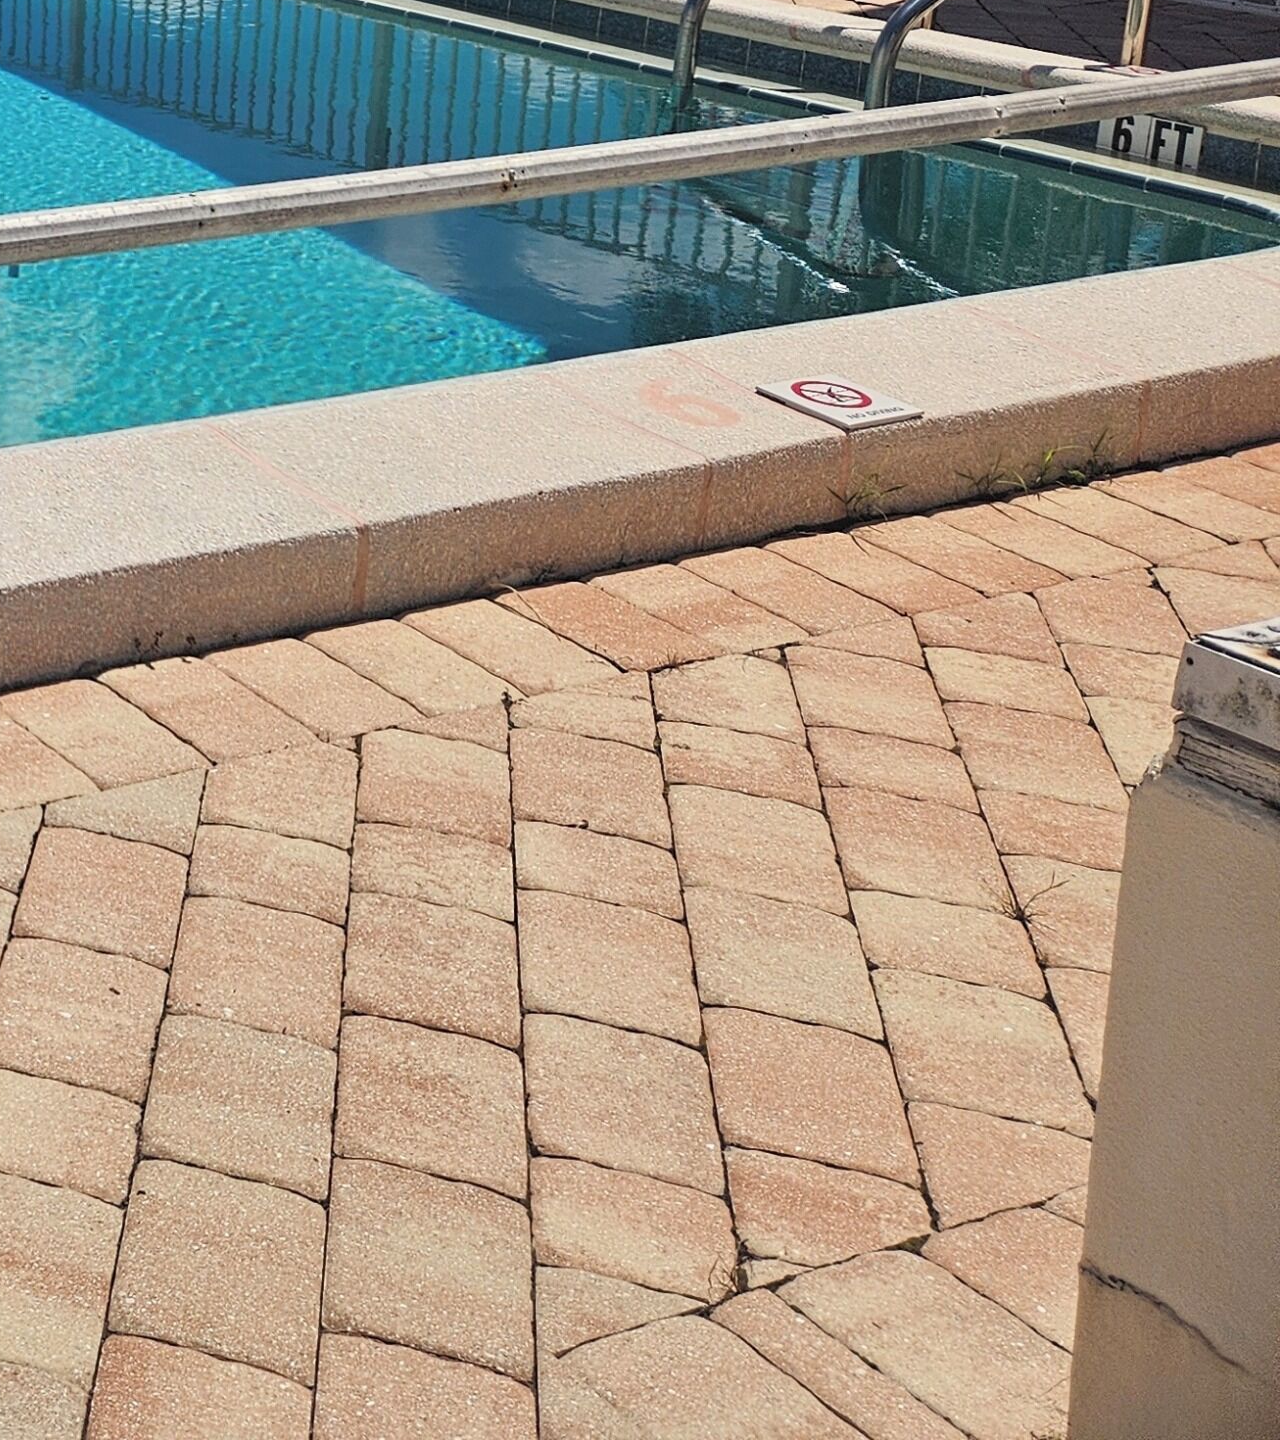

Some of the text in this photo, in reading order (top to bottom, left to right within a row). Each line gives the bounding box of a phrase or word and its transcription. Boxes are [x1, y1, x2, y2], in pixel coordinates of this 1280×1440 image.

[1111, 116, 1194, 167] 6 FT
[846, 406, 905, 420] NO DIVING
